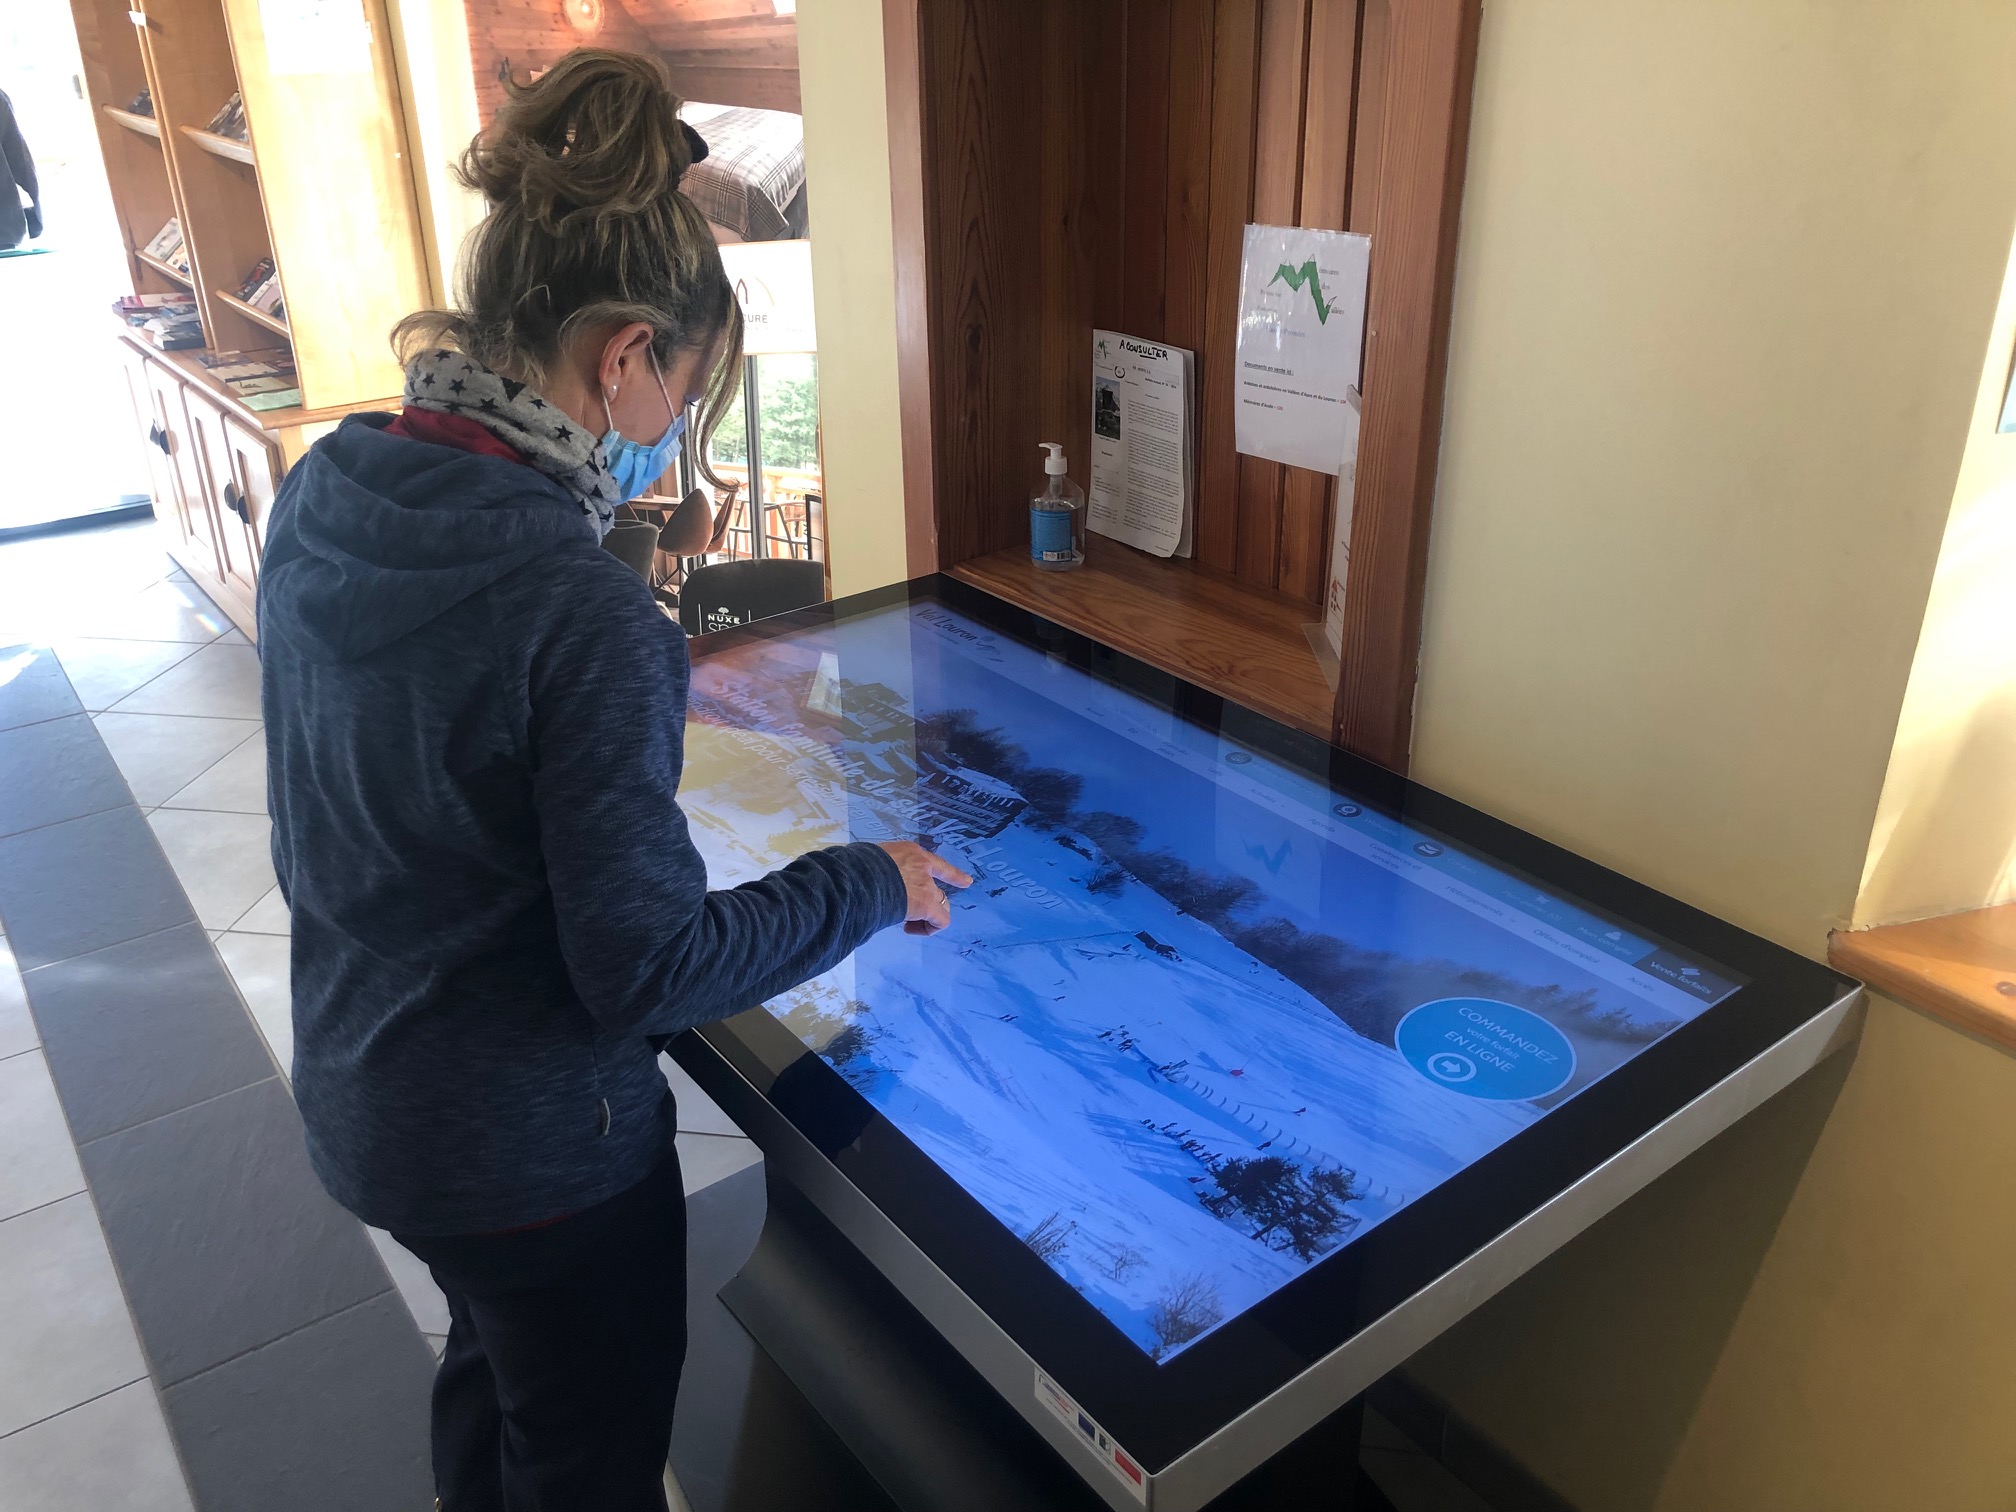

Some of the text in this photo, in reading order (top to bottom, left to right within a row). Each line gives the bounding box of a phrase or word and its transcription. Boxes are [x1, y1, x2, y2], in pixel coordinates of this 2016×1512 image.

[1126, 341, 1169, 361] CONSULTER
[707, 613, 741, 625] NUXE
[933, 618, 978, 642] Louron
[746, 743, 788, 765] pour
[710, 681, 778, 724] Station
[860, 778, 896, 797] de
[889, 798, 940, 823] ski
[926, 818, 986, 851] Val
[967, 846, 1064, 910] Louron
[1650, 960, 1678, 978] Vente
[1458, 1007, 1560, 1065] COMMANDEZ
[1466, 1027, 1521, 1061] votre forfait
[1444, 1030, 1517, 1073] EN LIGNE
